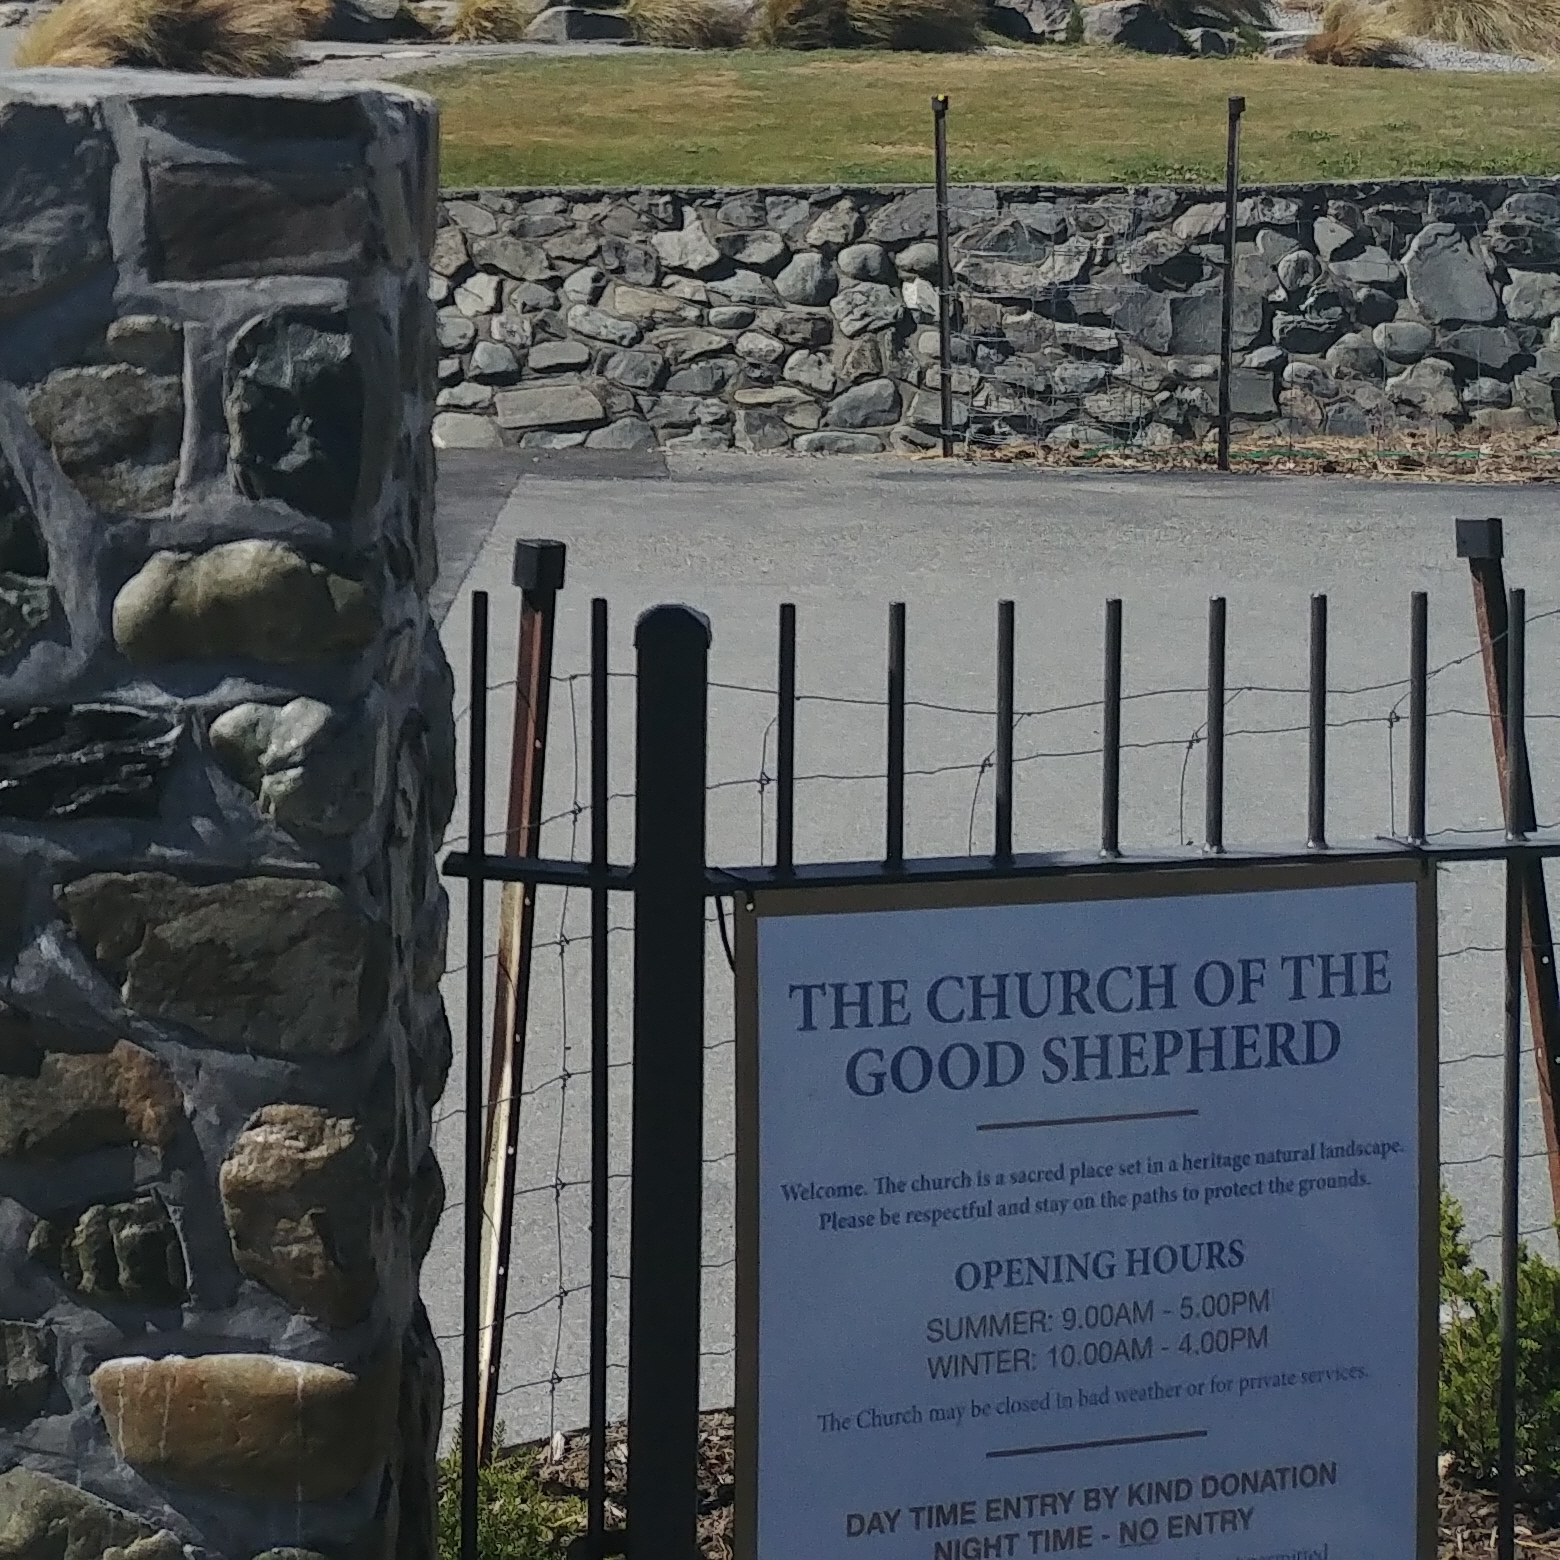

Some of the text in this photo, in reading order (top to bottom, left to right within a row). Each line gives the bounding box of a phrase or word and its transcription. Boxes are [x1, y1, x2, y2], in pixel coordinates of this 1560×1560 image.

[789, 950, 1392, 1031] THE CHURCH OF THE
[846, 1019, 1340, 1097] GOOD SHEPHERD
[781, 1139, 1403, 1202] Welcome. The church is a sacred place set in a heritage natural landscape.
[818, 1168, 1371, 1231] Please be respectful and stay on the paths to protect the grounds.
[955, 1239, 1245, 1292] OPENING HOURS
[926, 1309, 1053, 1343] SUMMER:
[1062, 1299, 1154, 1331] 9.00AM
[1180, 1289, 1270, 1320] 5.00PM
[927, 1348, 1037, 1379] WINTER:
[1049, 1336, 1153, 1368] 10.00AM
[1178, 1325, 1268, 1356] 4.00PM
[817, 1364, 1369, 1432] The Church may be closed in bad weather or for private services.
[846, 1461, 1337, 1538] DAY TIME ENTRY BY KIND DONATION
[934, 1533, 1020, 1560] NIGHT
[1027, 1526, 1092, 1555] TIME
[1119, 1518, 1159, 1545] NO
[1167, 1507, 1254, 1539] ENTRY
